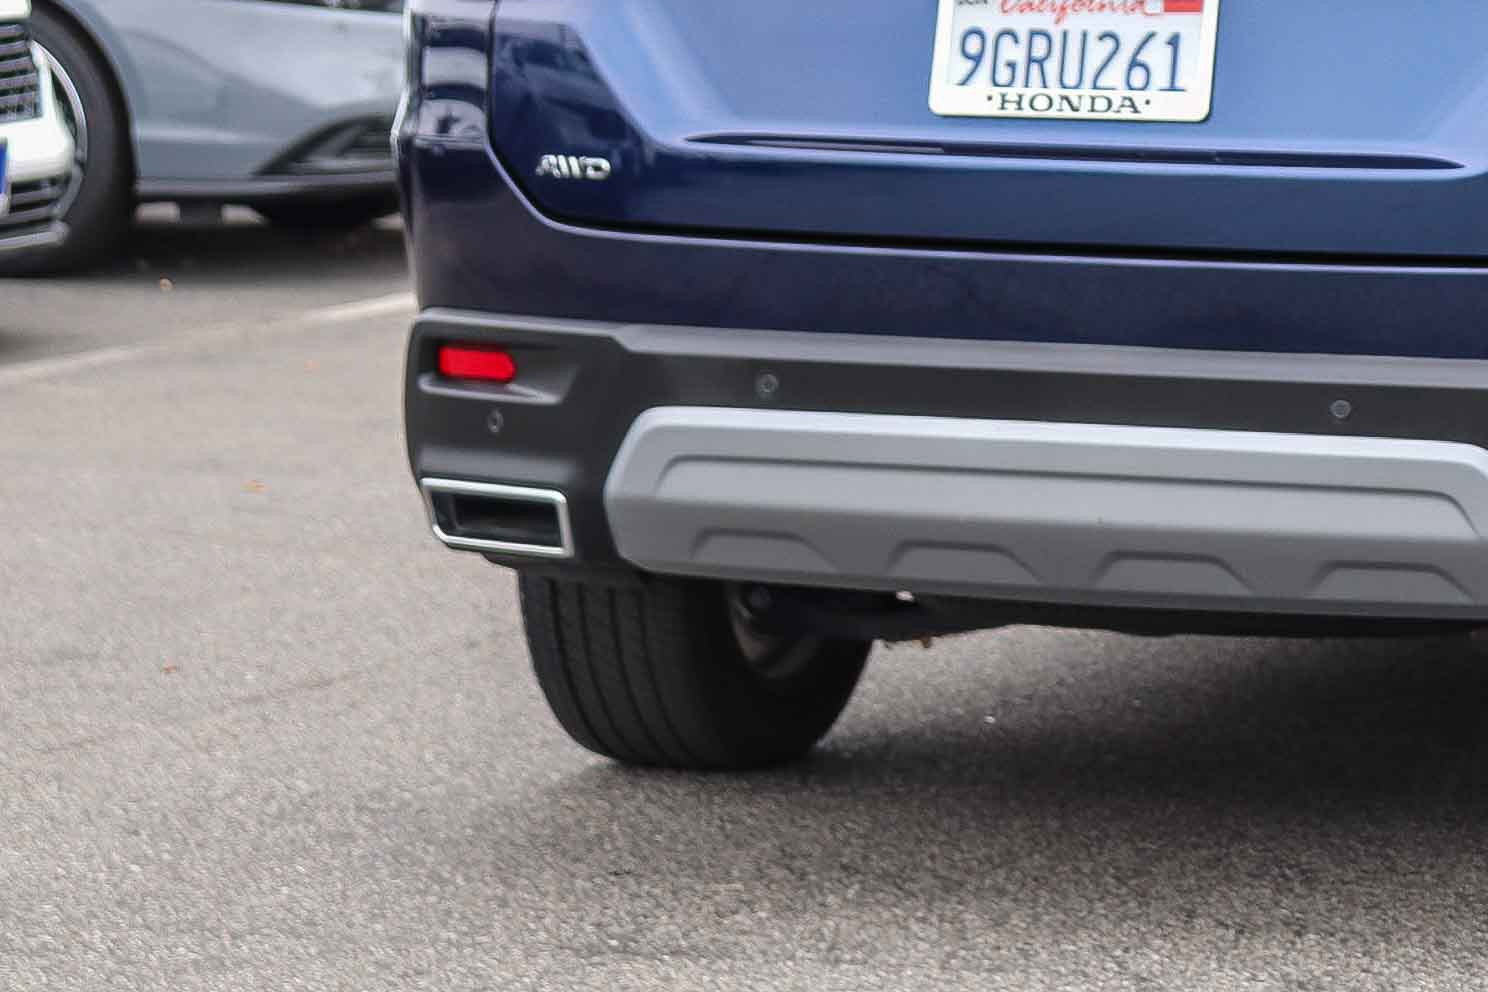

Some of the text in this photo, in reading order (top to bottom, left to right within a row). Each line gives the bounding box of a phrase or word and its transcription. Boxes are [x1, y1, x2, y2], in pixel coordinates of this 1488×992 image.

[955, 25, 1187, 93] 9GRU261
[997, 92, 1142, 115] HONDA
[535, 154, 612, 180] AWD
